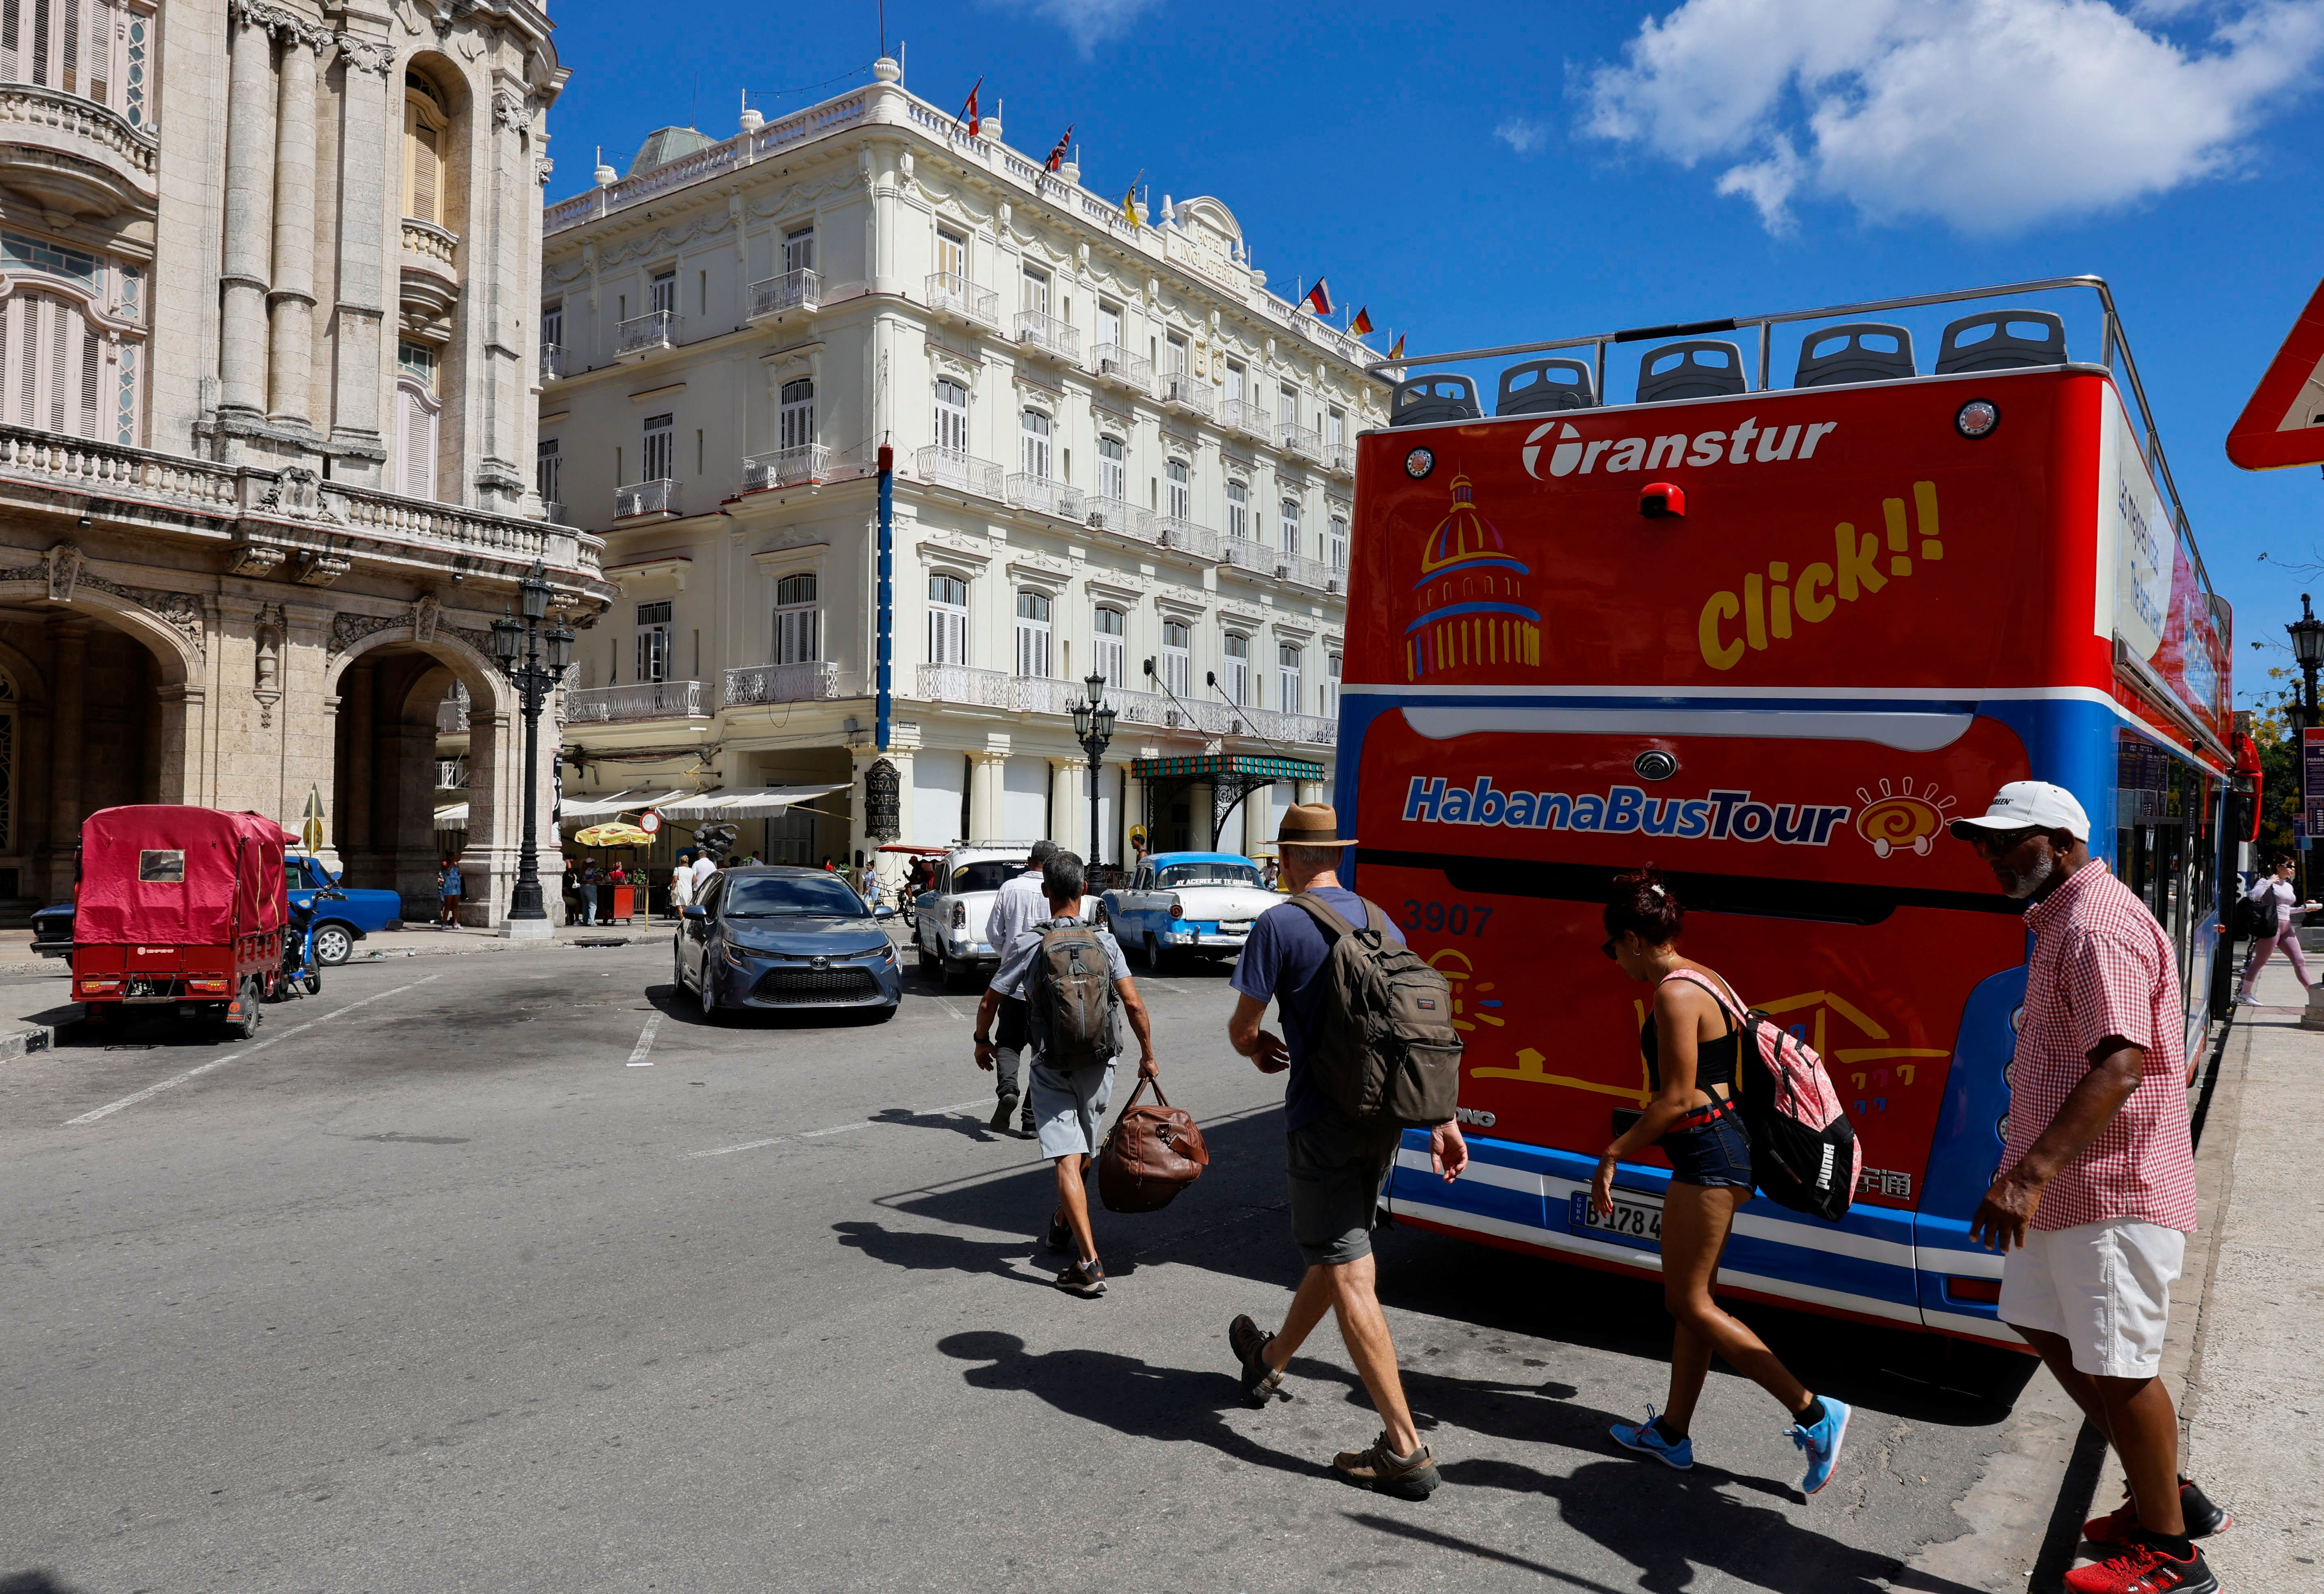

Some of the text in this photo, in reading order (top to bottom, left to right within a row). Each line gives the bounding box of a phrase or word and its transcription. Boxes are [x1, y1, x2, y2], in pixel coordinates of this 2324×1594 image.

[1197, 229, 1225, 257] HOTEL
[1180, 242, 1239, 289] INGLATERRA
[1522, 416, 1838, 481] Transtur
[2119, 461, 2159, 576] Las mejores vistas
[1699, 481, 1943, 671] Click!!
[2130, 559, 2139, 613] The
[2140, 572, 2150, 627] best
[870, 780, 897, 791] GRAN
[871, 794, 895, 805] CAFE
[868, 815, 898, 826] LOUVRE
[1402, 899, 1493, 937] 3907
[1815, 1143, 1835, 1190] PUMA
[2162, 1567, 2178, 1580] adidas
